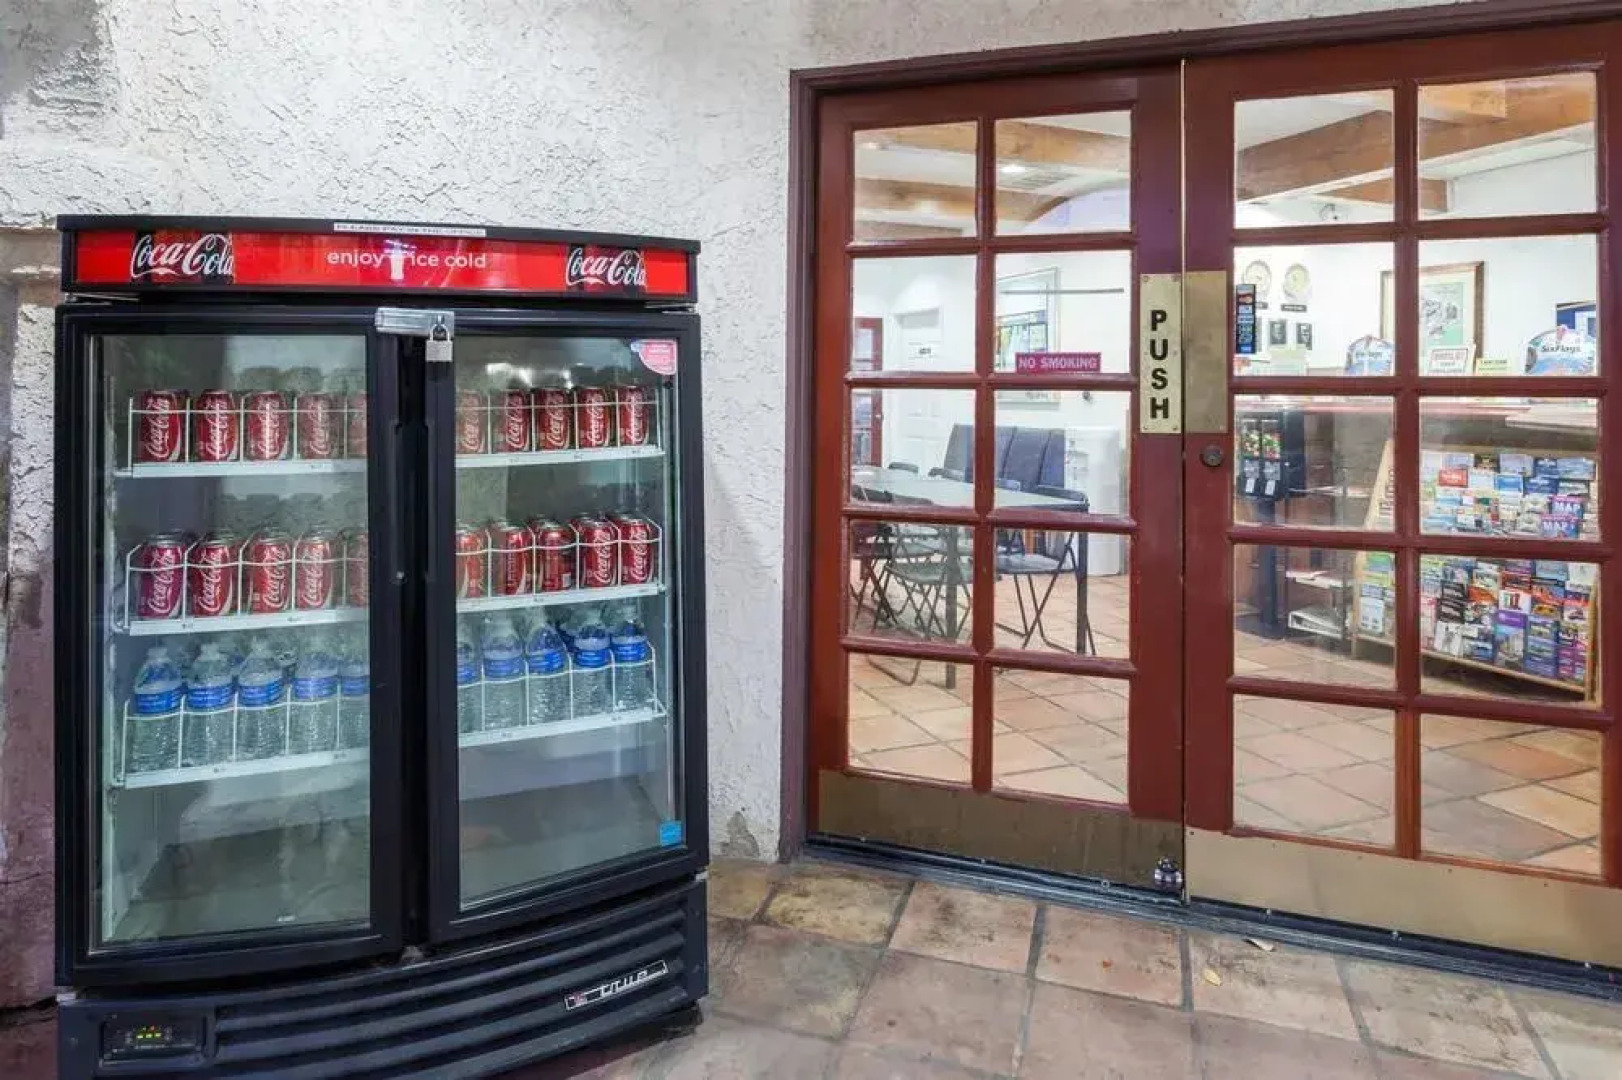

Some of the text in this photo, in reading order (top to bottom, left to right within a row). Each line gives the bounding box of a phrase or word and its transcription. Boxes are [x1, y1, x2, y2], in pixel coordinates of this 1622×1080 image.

[130, 234, 233, 278] Coca-Cola
[326, 251, 487, 268] enjoy ice cold
[565, 247, 647, 286] Coca-Cola
[1018, 356, 1098, 369] NO SMOKING
[1149, 309, 1169, 419] PUSH
